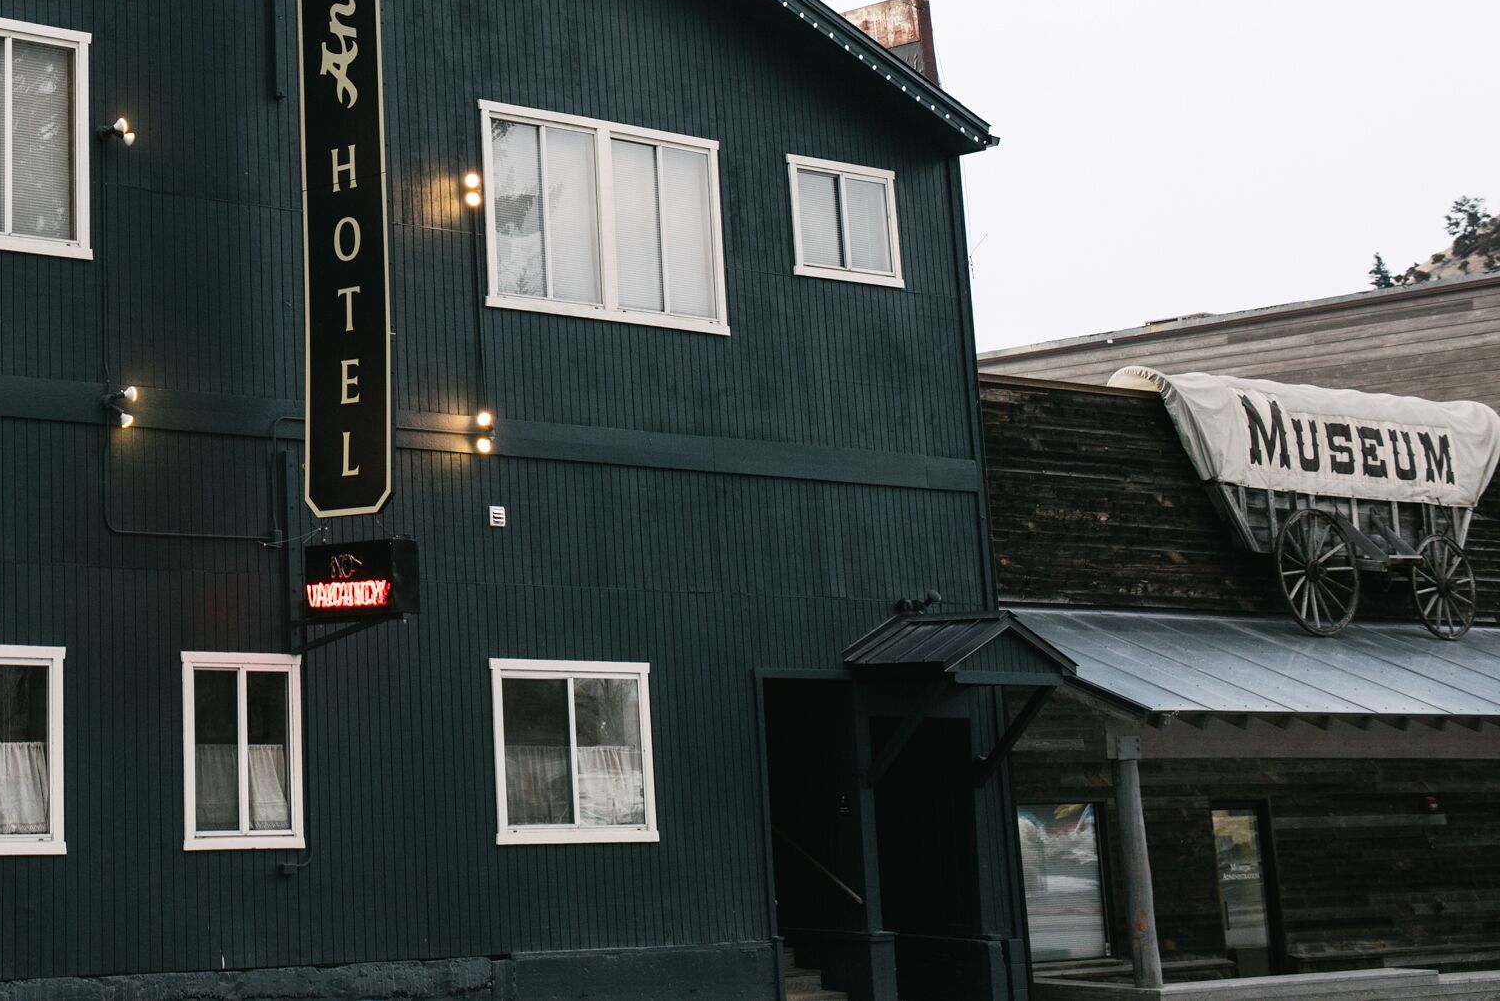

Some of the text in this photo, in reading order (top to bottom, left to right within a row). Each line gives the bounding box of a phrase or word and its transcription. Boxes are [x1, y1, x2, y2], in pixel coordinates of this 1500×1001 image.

[331, 144, 360, 477] HOTEL
[1238, 394, 1455, 485] MUSEUM
[306, 580, 389, 608] VACANCY
